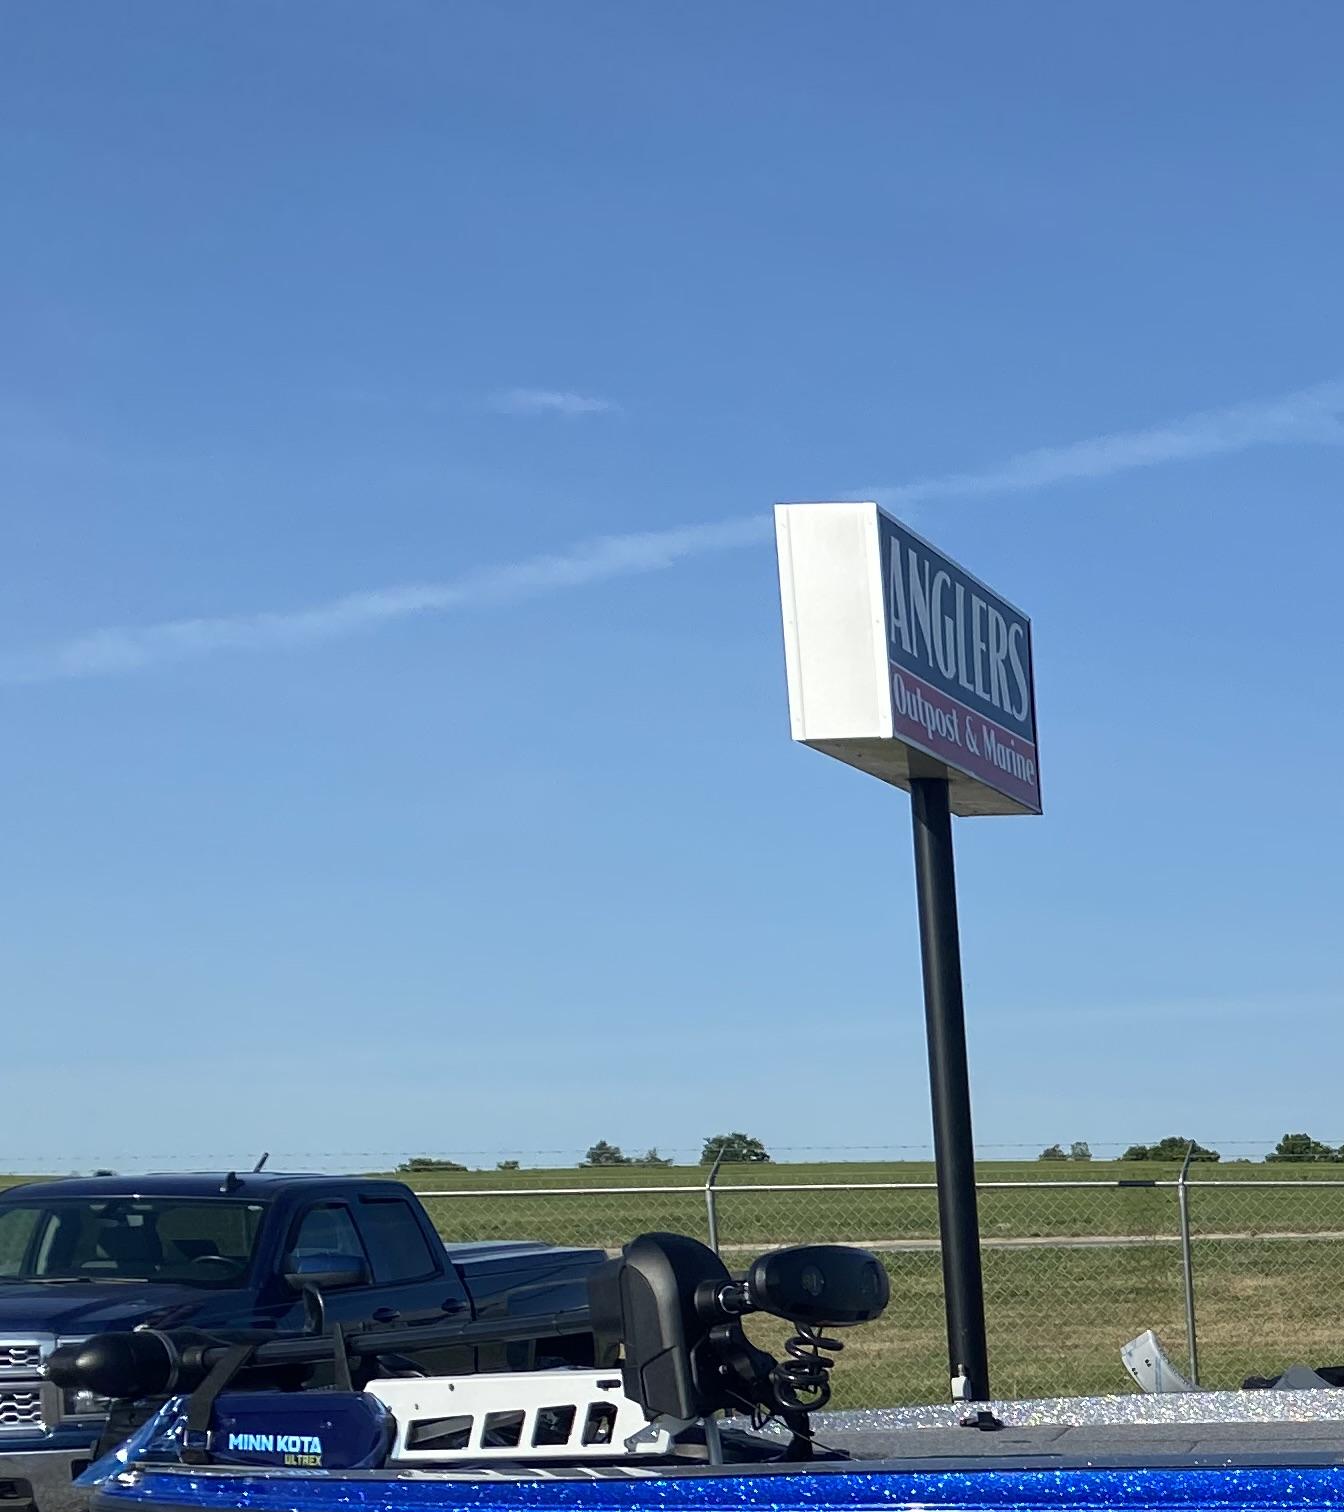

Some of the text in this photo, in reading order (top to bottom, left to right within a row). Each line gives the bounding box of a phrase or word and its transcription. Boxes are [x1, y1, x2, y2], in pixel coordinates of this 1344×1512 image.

[889, 535, 1029, 722] ANGLERS
[894, 673, 1036, 786] Outpost & Marine
[229, 1433, 321, 1453] MINN KOTA
[285, 1454, 322, 1466] ULTREX
